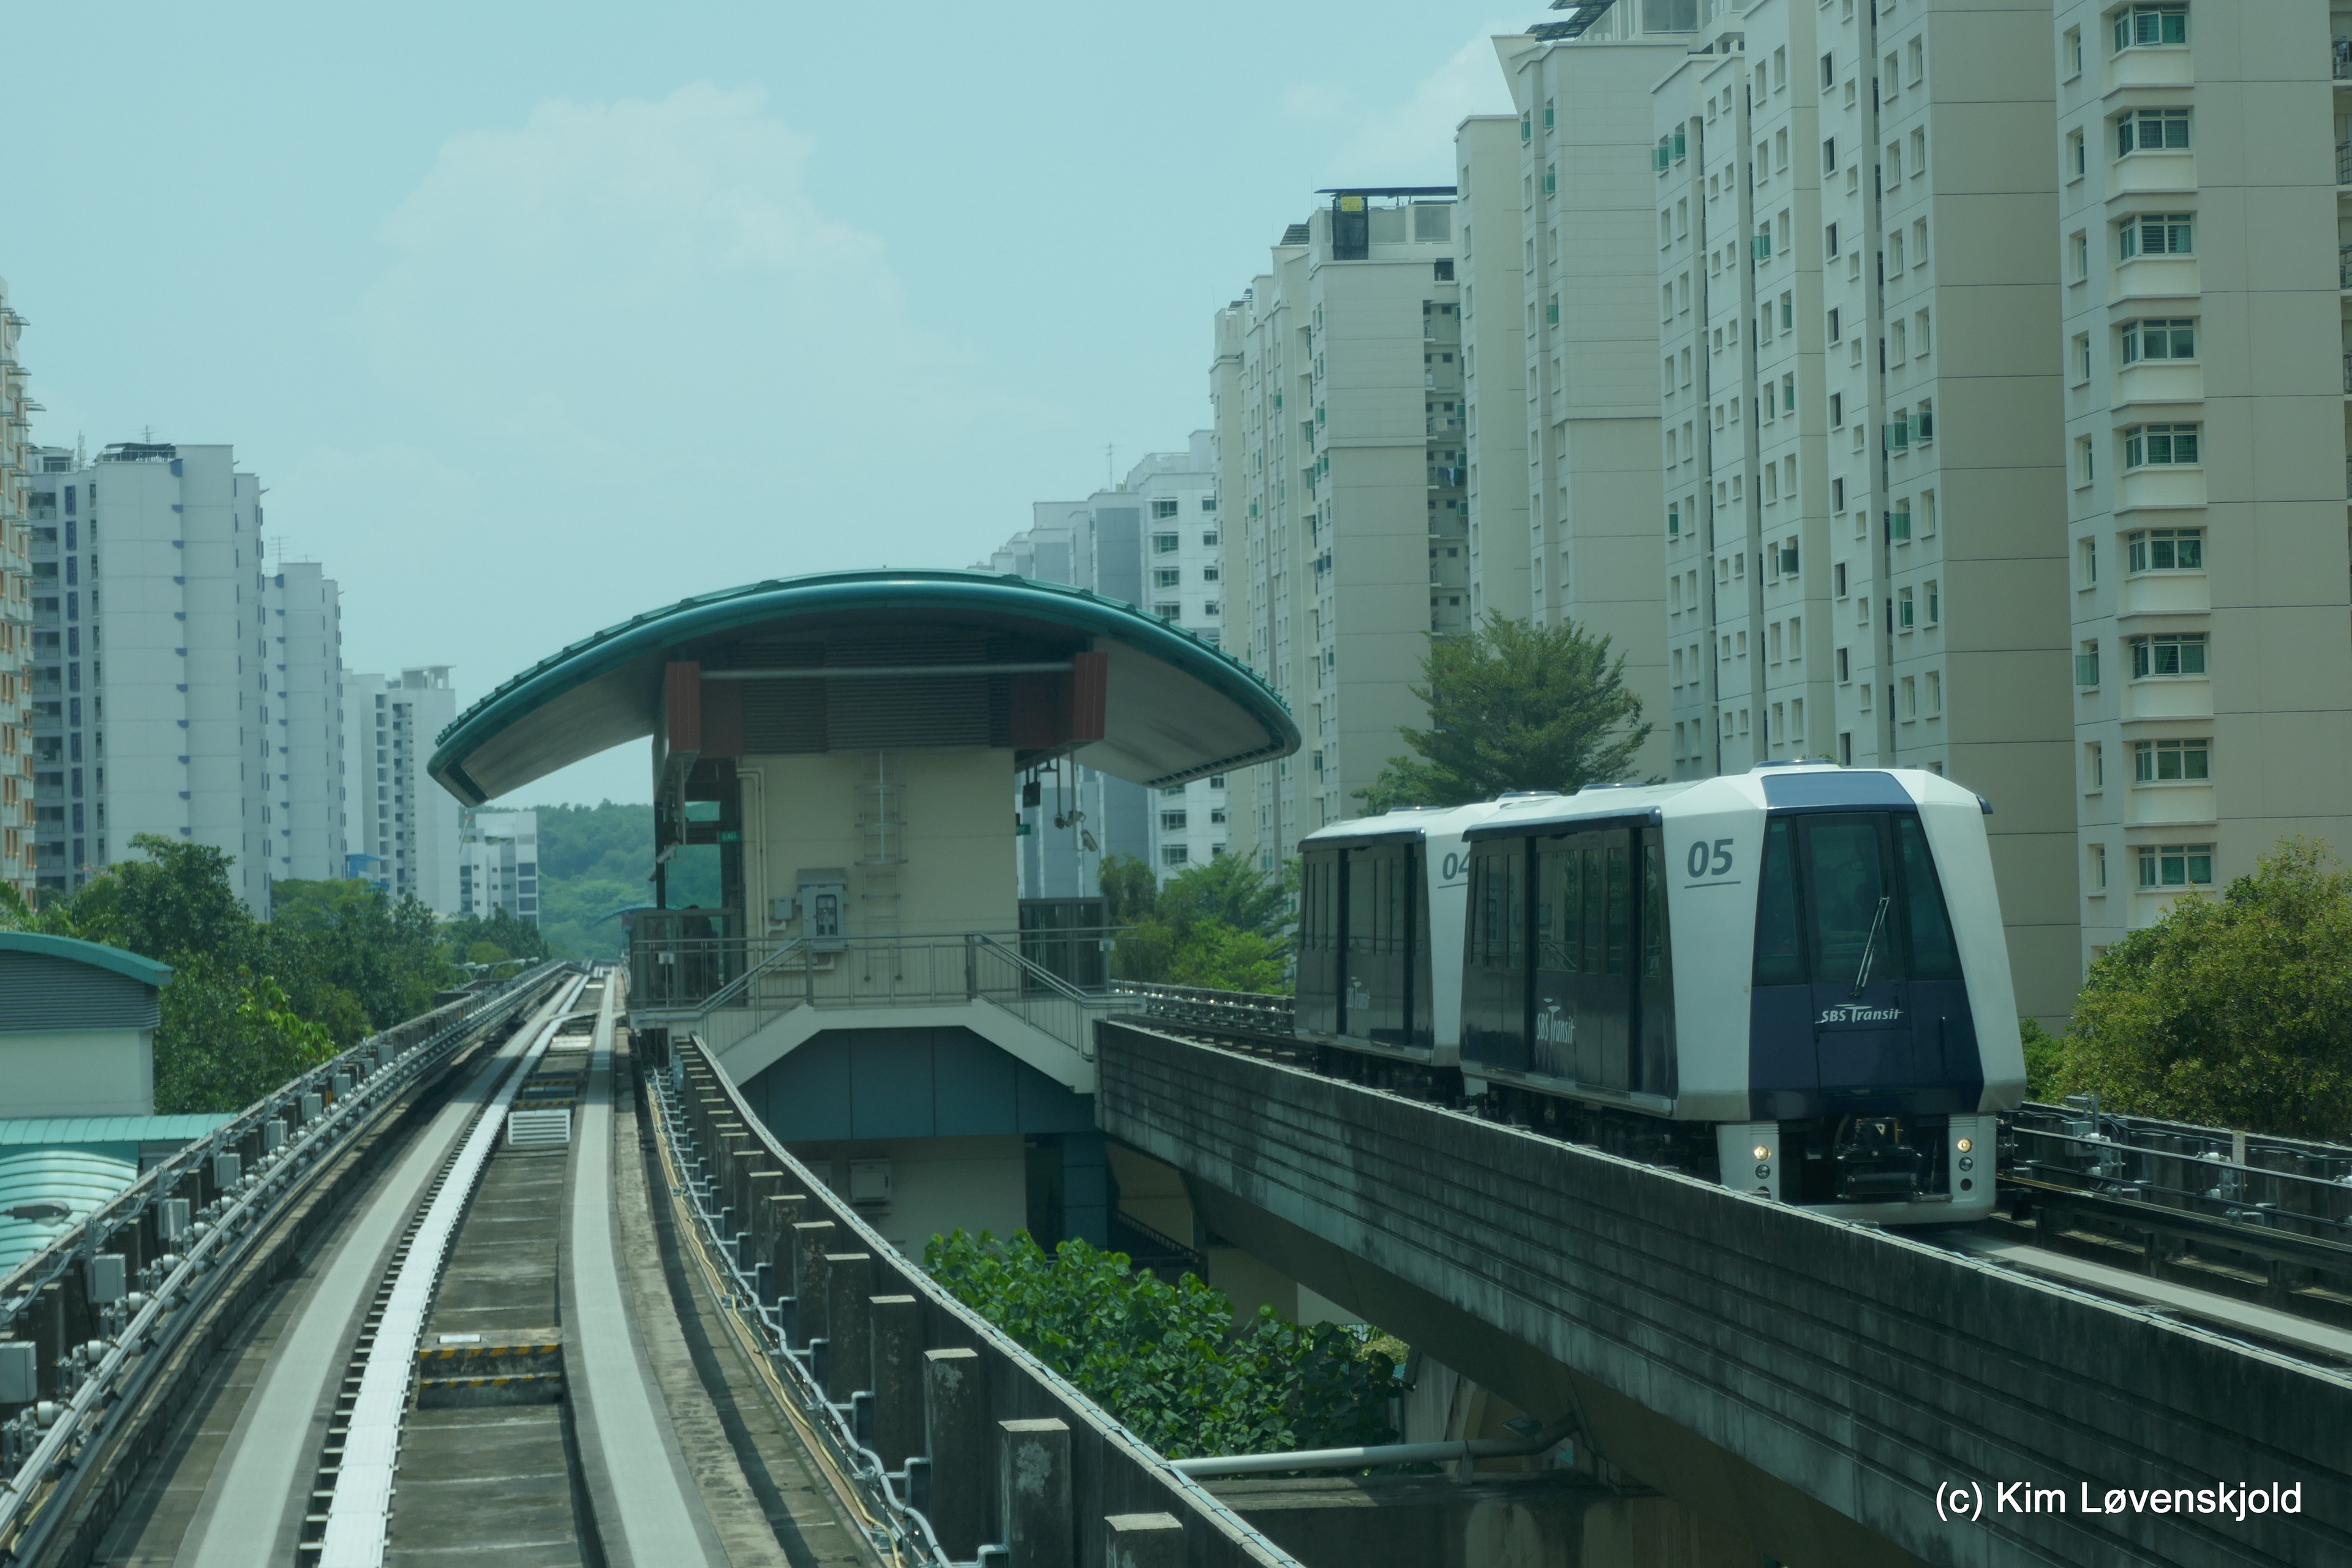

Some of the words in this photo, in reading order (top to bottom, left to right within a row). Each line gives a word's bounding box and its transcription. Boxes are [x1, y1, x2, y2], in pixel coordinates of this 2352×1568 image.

[1687, 838, 1733, 878] 05
[1537, 1012, 1549, 1041] SBS
[1547, 1005, 1575, 1047] Transit
[1820, 1010, 1846, 1022] SBS
[1844, 1006, 1904, 1023] Transit
